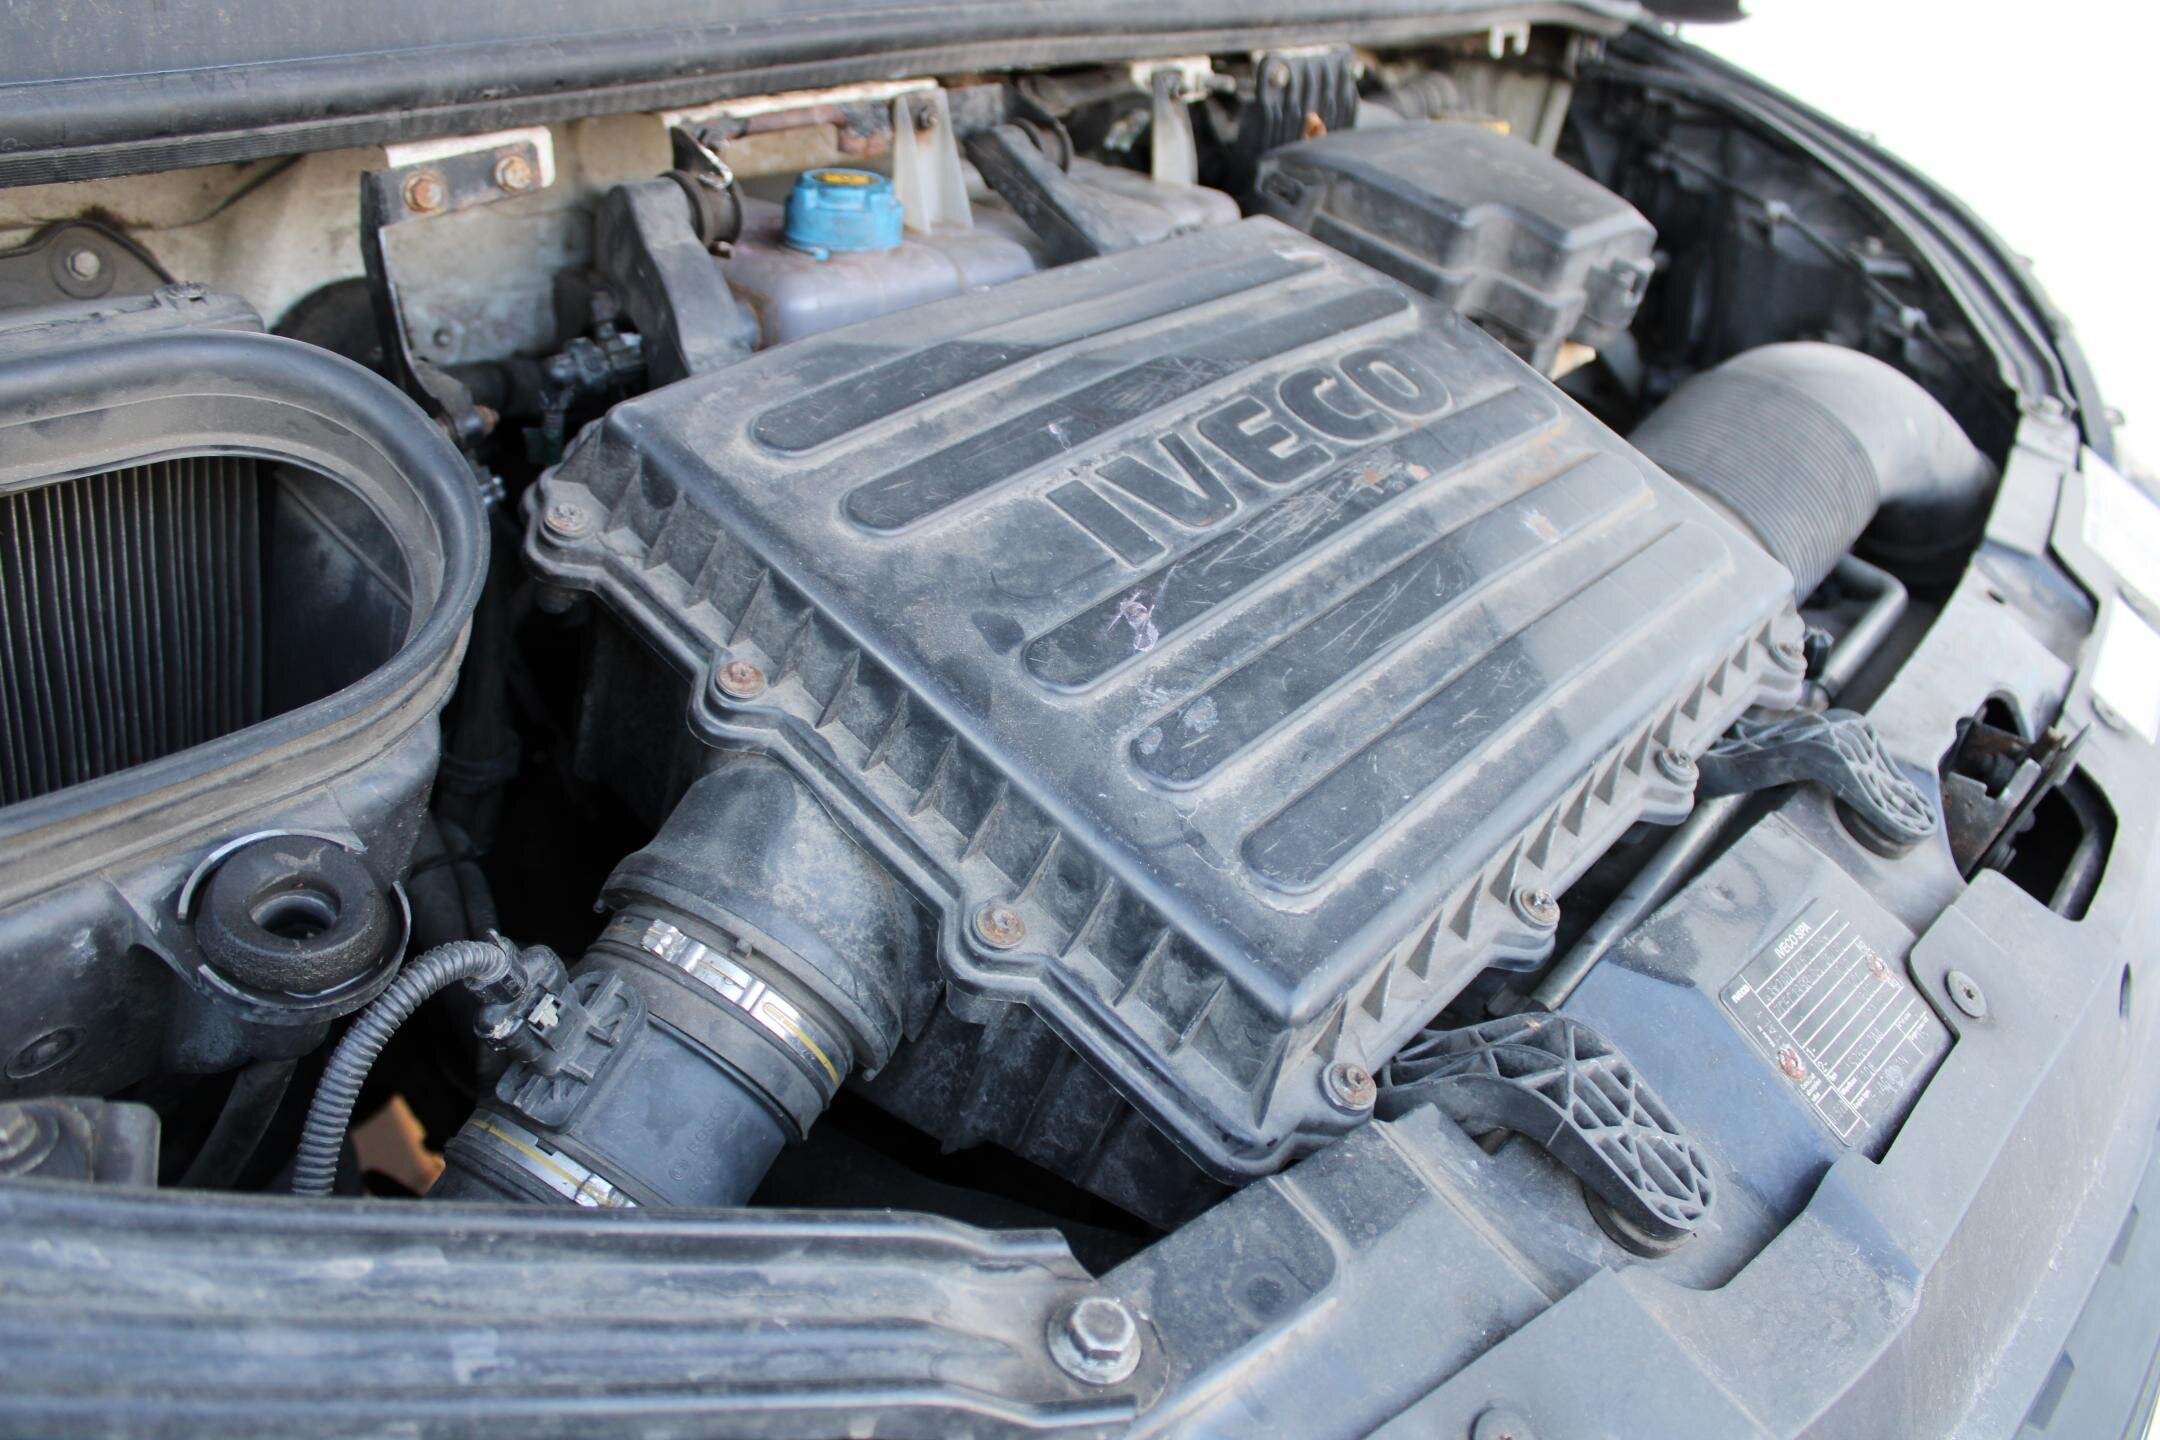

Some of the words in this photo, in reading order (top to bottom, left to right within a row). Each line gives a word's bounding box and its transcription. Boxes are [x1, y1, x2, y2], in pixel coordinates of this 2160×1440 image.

[1044, 346, 1454, 569] IVECO
[1774, 934, 1799, 960] IVECO
[1794, 922, 1812, 940] SPA
